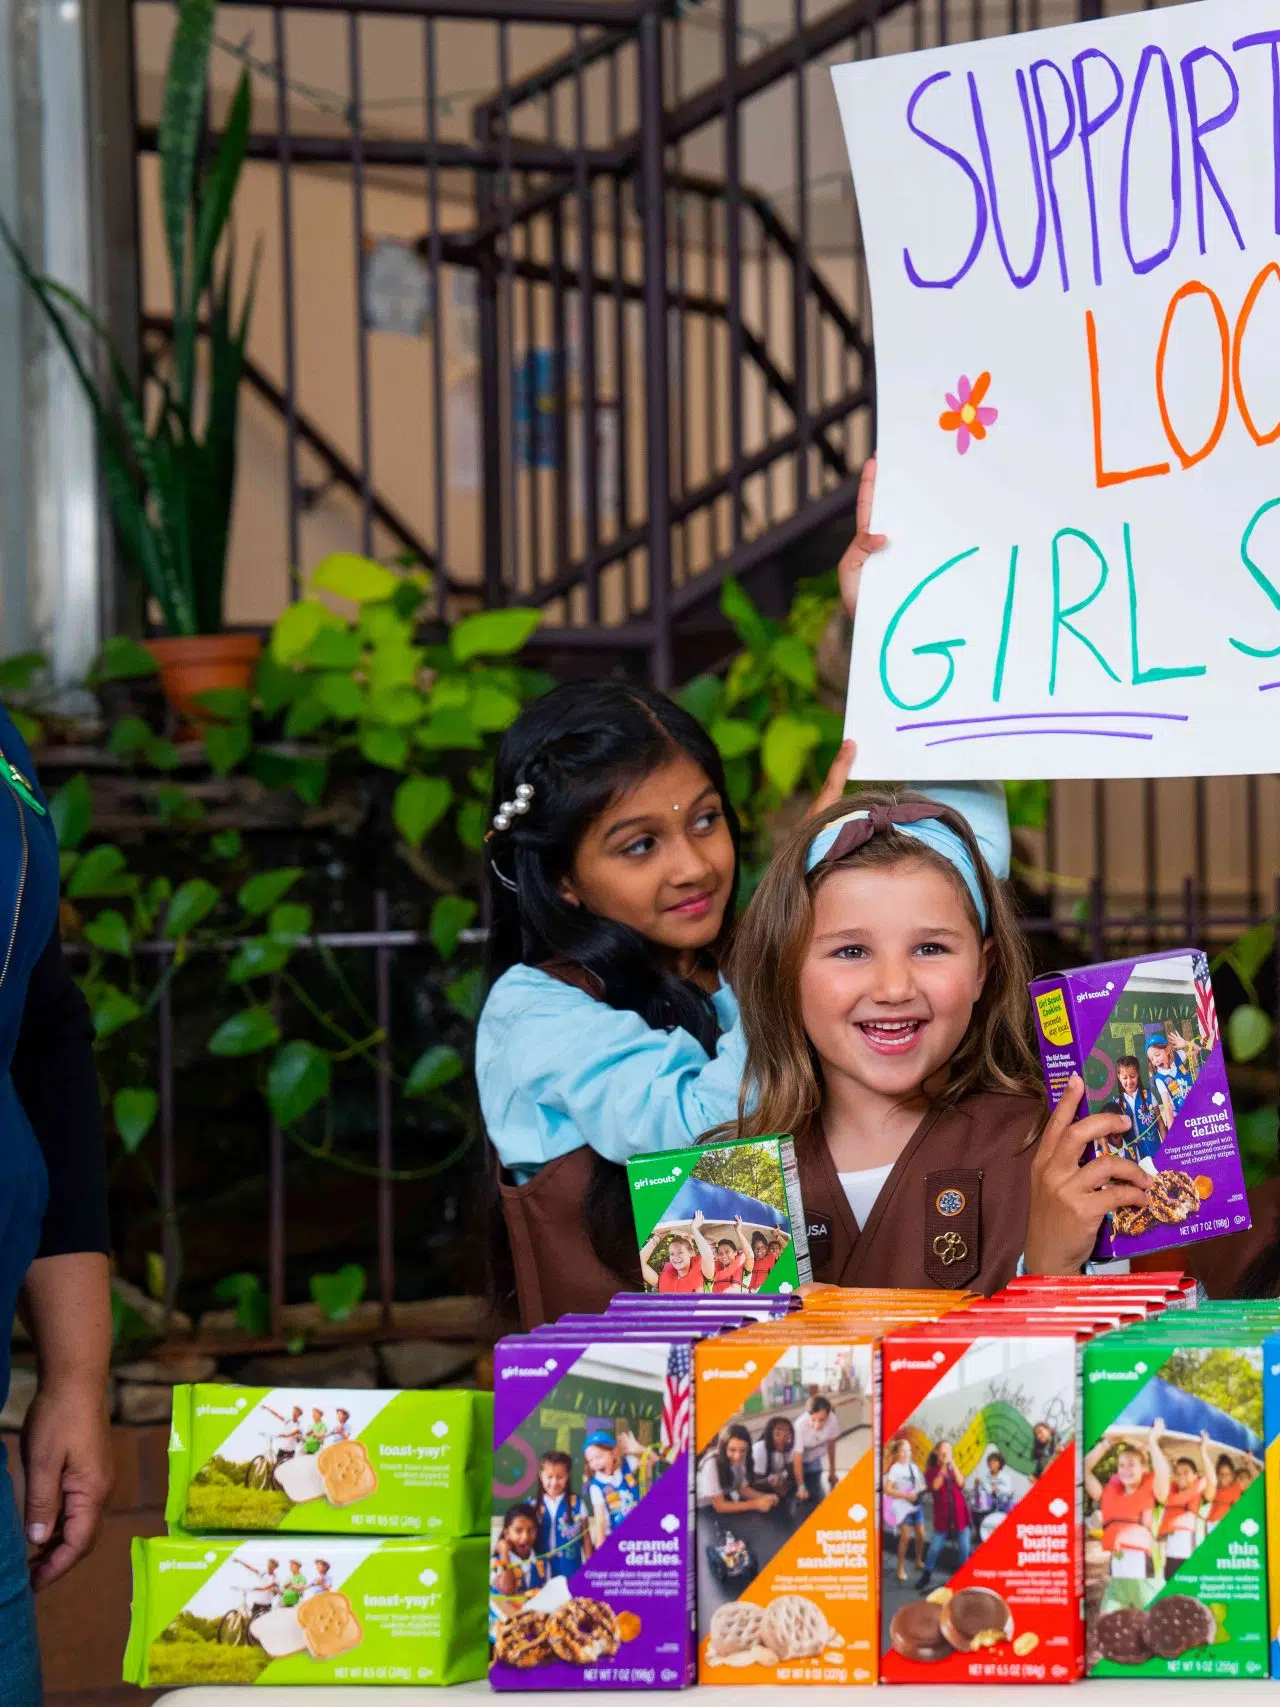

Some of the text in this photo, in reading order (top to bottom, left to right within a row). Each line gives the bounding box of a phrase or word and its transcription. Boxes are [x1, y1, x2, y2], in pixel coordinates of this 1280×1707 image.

[879, 523, 1206, 711] GIRL
[1076, 988, 1110, 1003] girl scouts
[1184, 1109, 1228, 1128] caramel
[1202, 1138, 1220, 1147] topped
[634, 1175, 676, 1190] girl scouts
[1180, 1224, 1190, 1236] NET
[1191, 1223, 1199, 1234] WT
[1205, 1221, 1212, 1230] OZ
[502, 1366, 549, 1380] girl scouts
[816, 1528, 868, 1544] peanut
[1016, 1523, 1067, 1539] peanut
[618, 1536, 679, 1552] caramel
[822, 1542, 868, 1555] butter
[1023, 1536, 1067, 1550] butter
[1228, 1541, 1259, 1556] thin
[797, 1555, 868, 1568] sandwich
